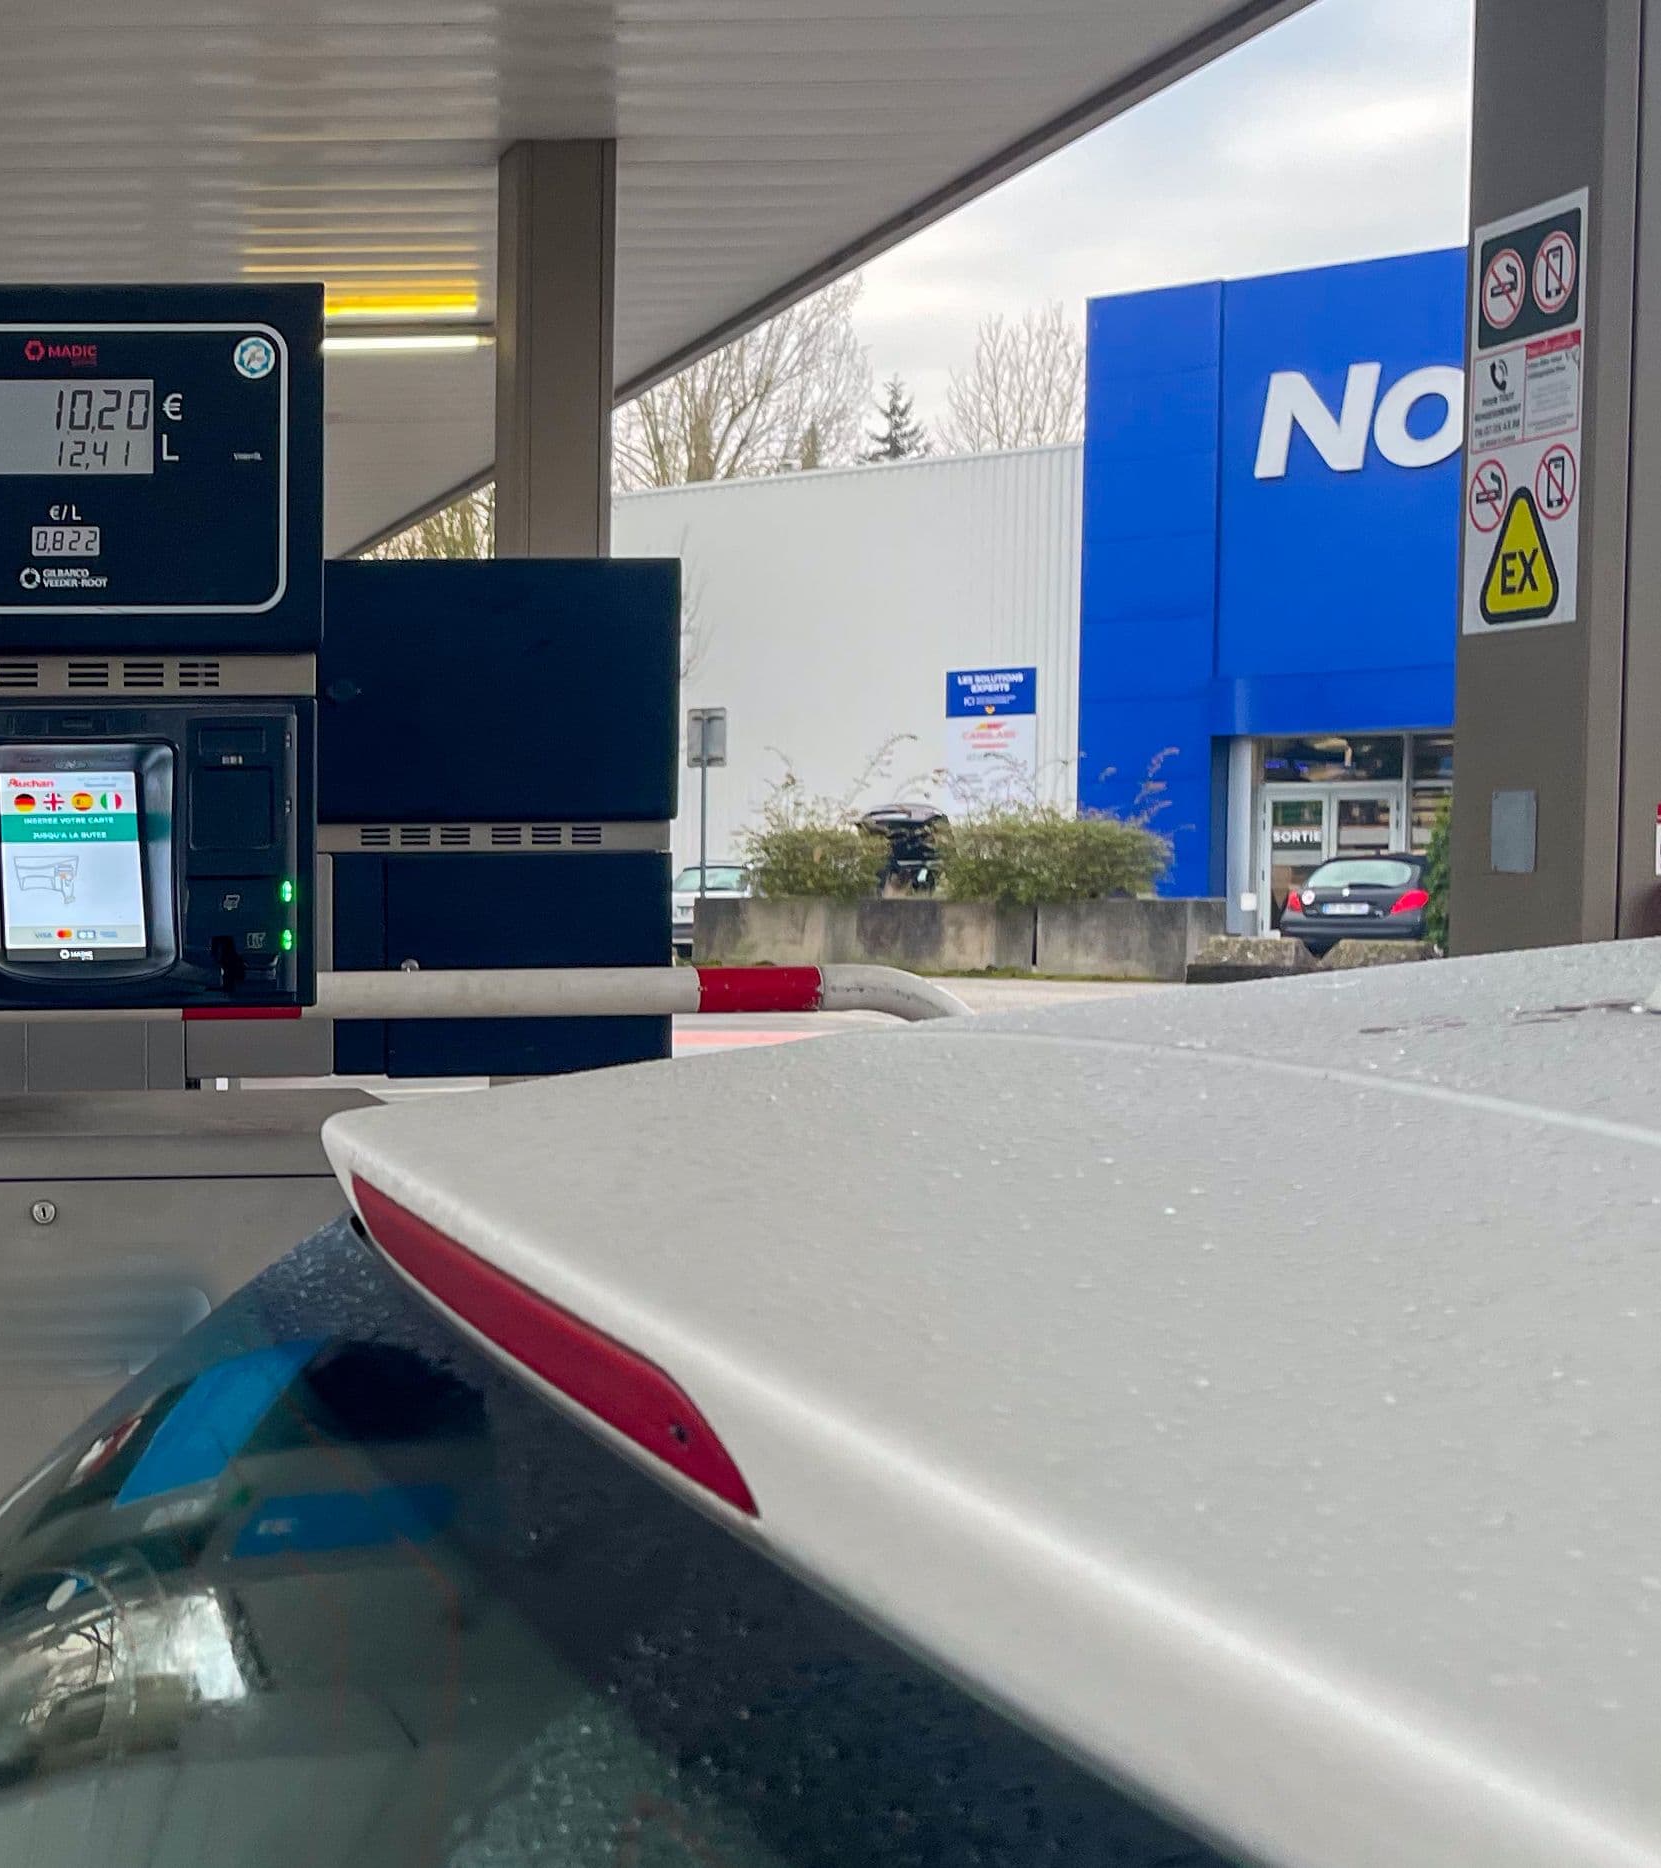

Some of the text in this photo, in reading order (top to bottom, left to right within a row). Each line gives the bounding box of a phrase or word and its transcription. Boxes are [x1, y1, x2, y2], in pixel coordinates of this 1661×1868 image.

[48, 346, 98, 359] MADIC
[56, 390, 150, 434] 10,20
[162, 393, 183, 420] €
[58, 441, 130, 470] 12,41
[162, 434, 179, 461] L
[36, 530, 98, 553] 0,822
[43, 568, 89, 578] GILBARCO
[43, 577, 108, 588] VEEDER-ROOT
[1501, 547, 1539, 596] EX
[8, 778, 54, 788] Auchan
[1273, 831, 1322, 843] SORTIE
